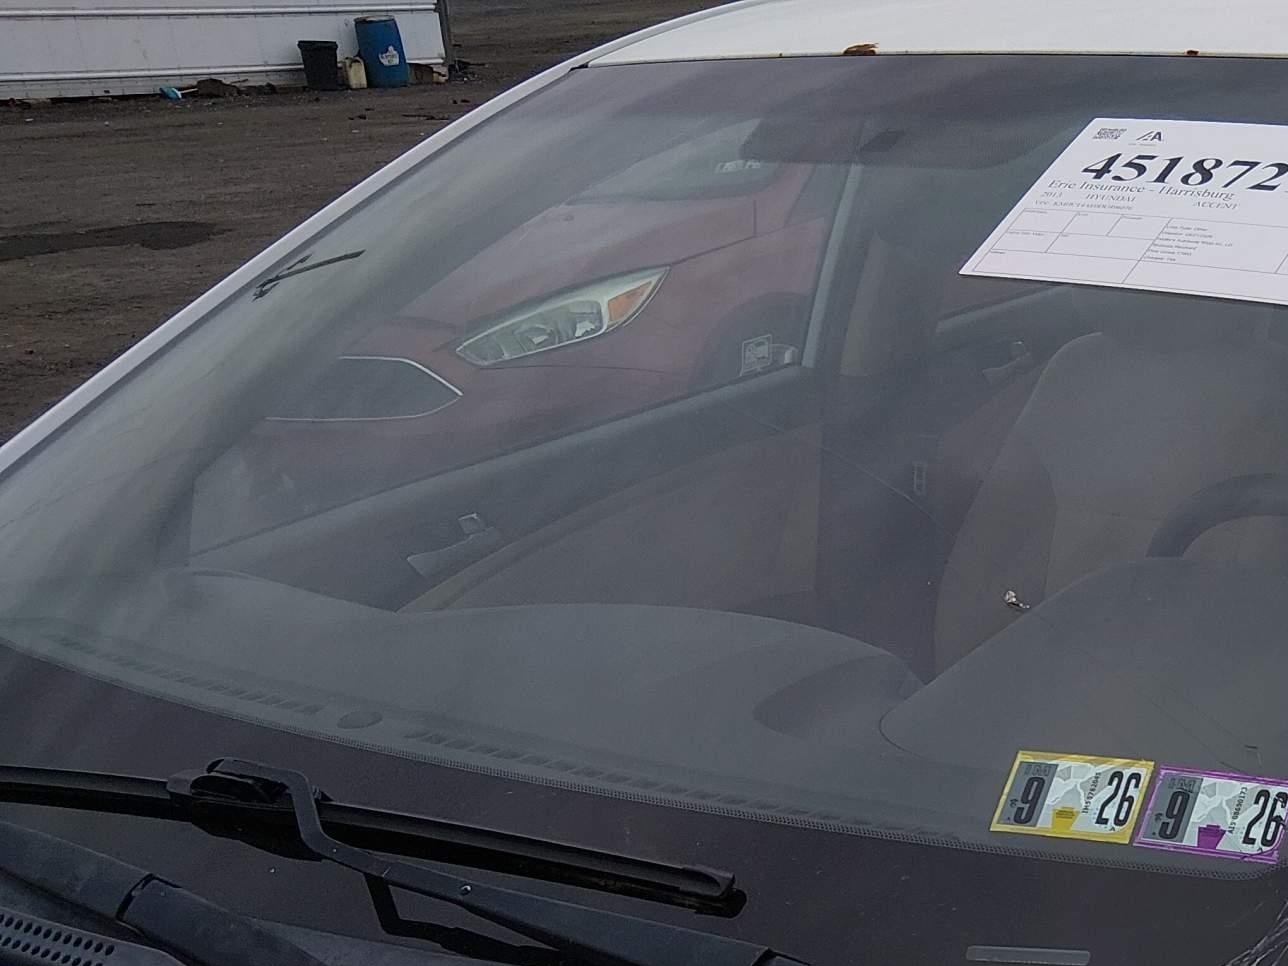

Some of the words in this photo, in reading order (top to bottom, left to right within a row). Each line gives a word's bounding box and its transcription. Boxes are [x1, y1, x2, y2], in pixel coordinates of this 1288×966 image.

[1080, 181, 1145, 193] Insurance
[1158, 185, 1236, 202] Harrisburg
[1013, 776, 1046, 825] 9
[1094, 770, 1143, 827] 26
[1157, 790, 1191, 840] 9
[1241, 789, 1288, 848] 26
